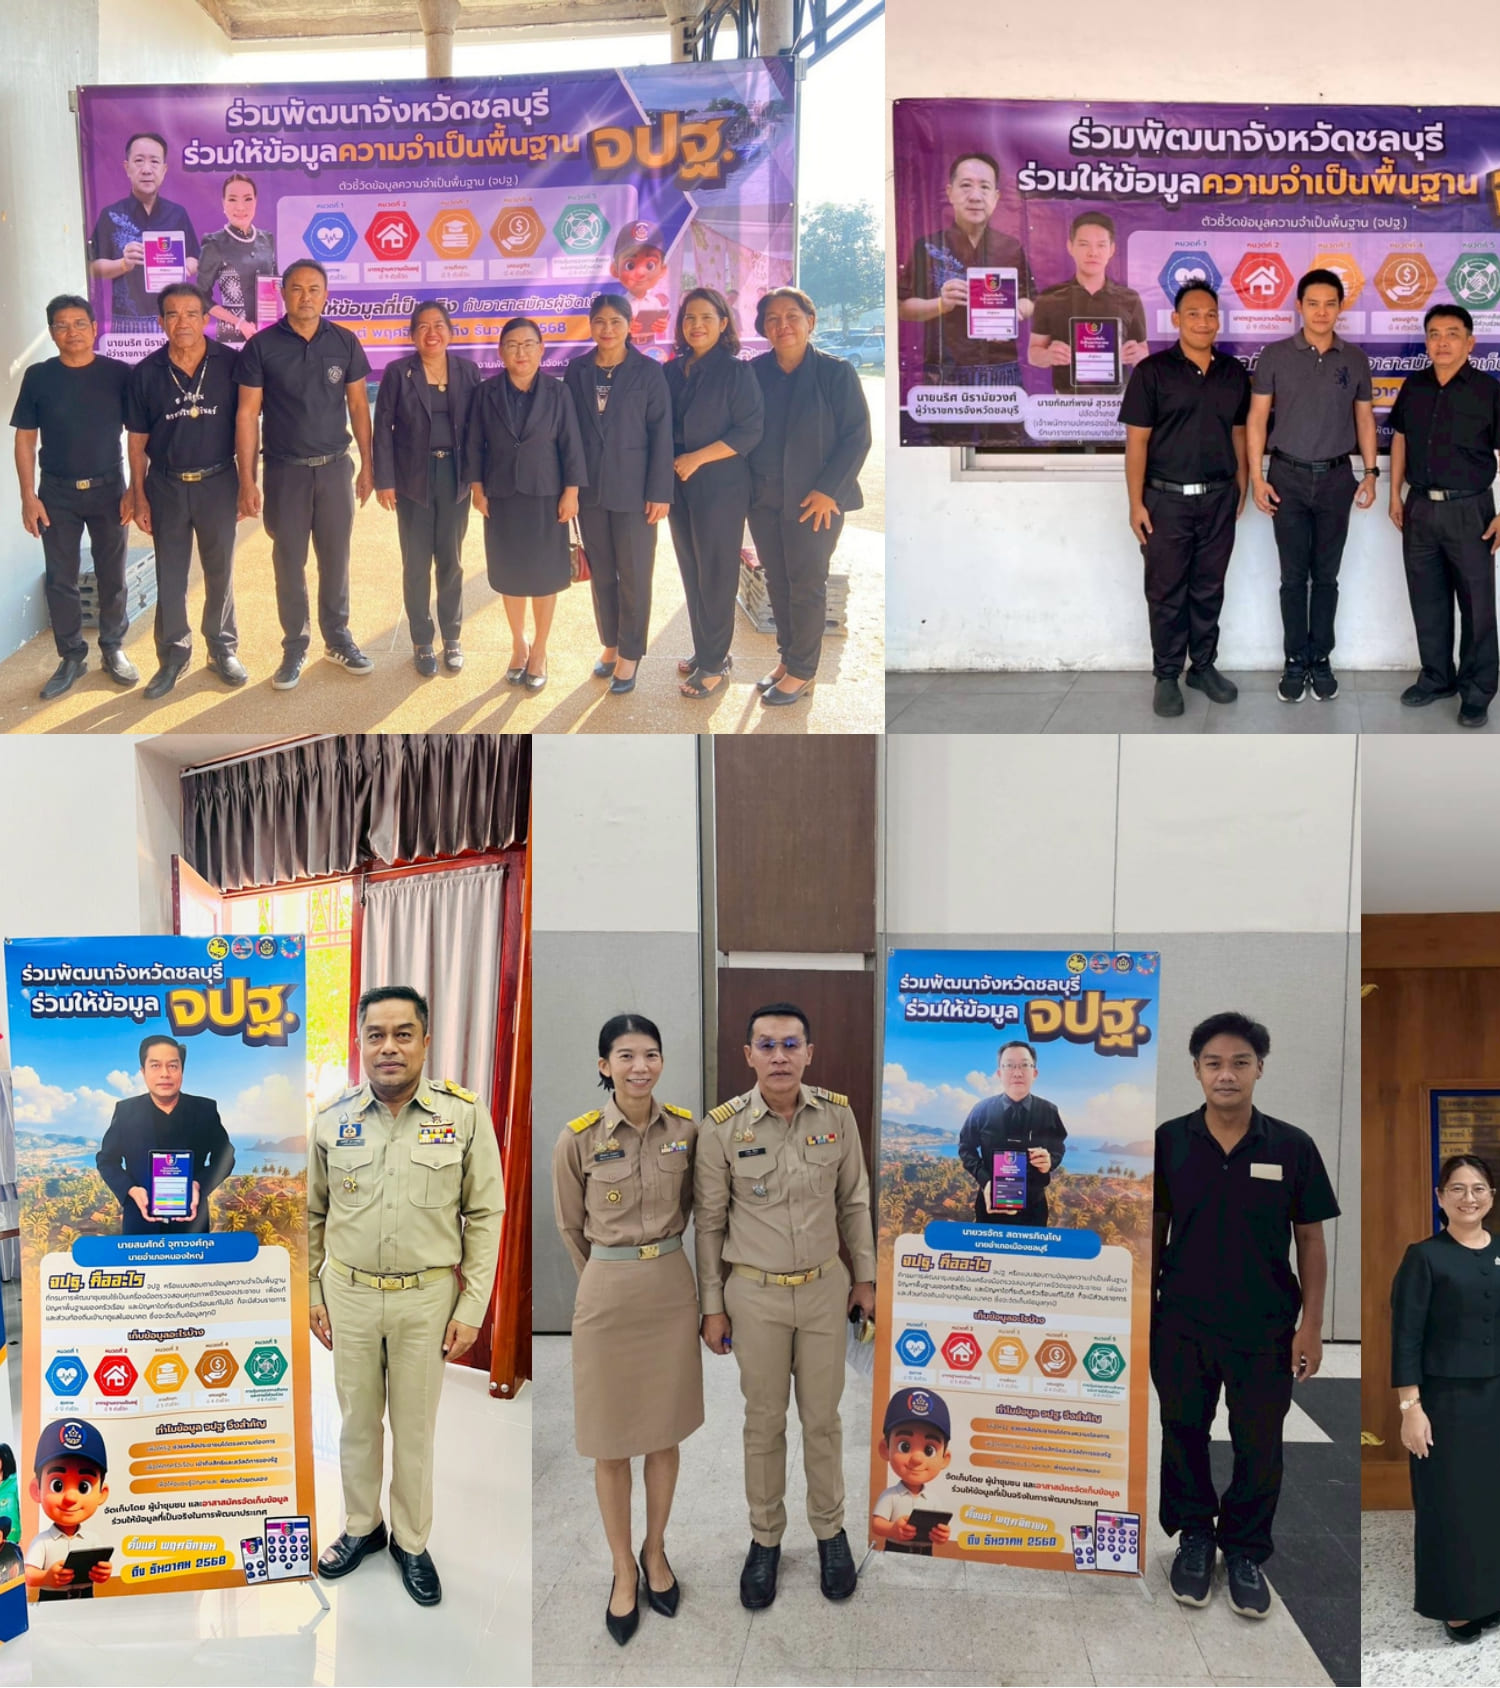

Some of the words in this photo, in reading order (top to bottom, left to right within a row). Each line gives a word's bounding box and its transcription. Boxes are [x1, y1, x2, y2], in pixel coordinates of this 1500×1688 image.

[225, 86, 550, 128] ร่วมพัฒนาจังหวัดชลบุรี
[594, 111, 735, 179] จปฐ.
[1071, 117, 1445, 162] ร่วมพัฒนาจังหวัดชลบุรี
[537, 321, 566, 334] 568
[21, 961, 224, 985] ร่วมพัฒนาจังหวัดชลบุรี
[900, 974, 1081, 997] ร่วมพัฒนาจังหวัดชลบุรี
[31, 990, 160, 1018] ร่วมให้ข้อมูล
[169, 977, 298, 1038] จปฐ.
[905, 999, 1019, 1025] ร่วมให้ข้อมูล
[1028, 990, 1150, 1049] จปฐ.
[89, 1269, 145, 1289] คืออะไร
